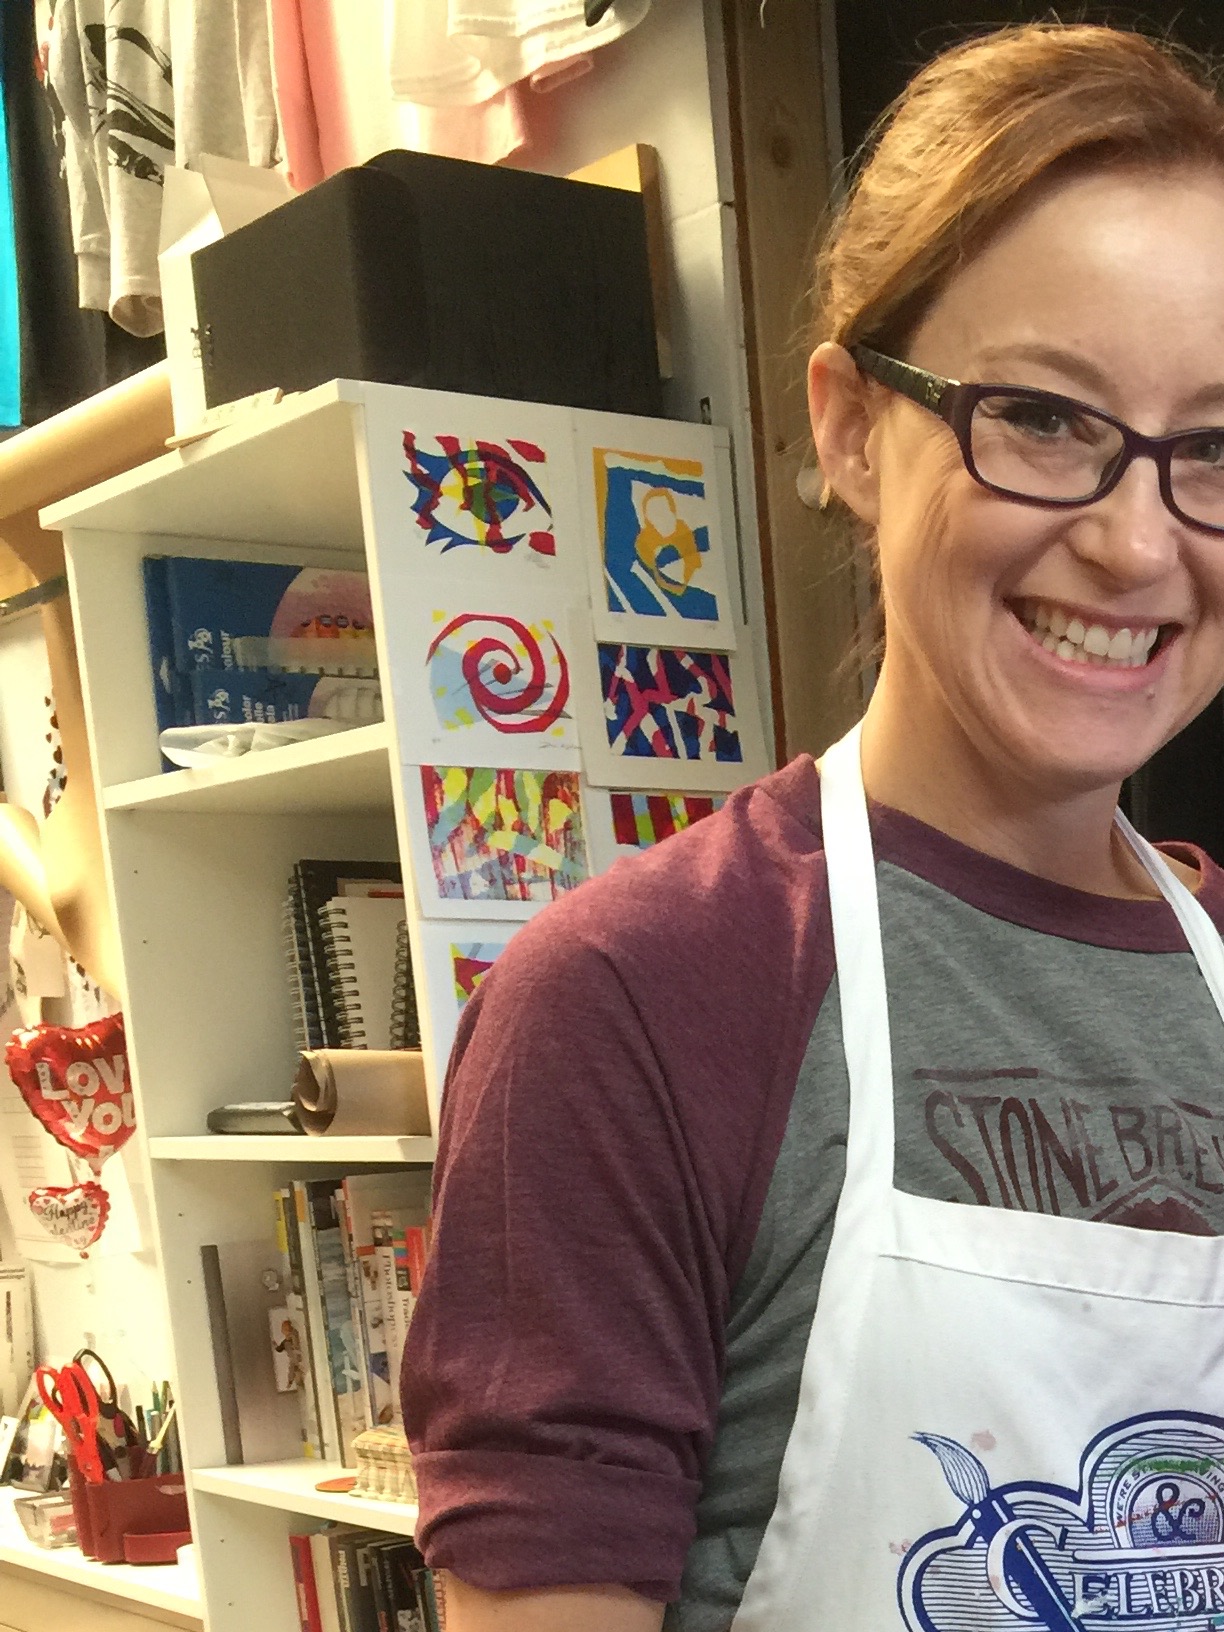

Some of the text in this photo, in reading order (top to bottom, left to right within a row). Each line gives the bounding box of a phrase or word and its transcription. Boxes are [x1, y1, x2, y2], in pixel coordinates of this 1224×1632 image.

[35, 1054, 126, 1100] LOV
[925, 1089, 1119, 1217] STONE
[1150, 1482, 1206, 1541] &
